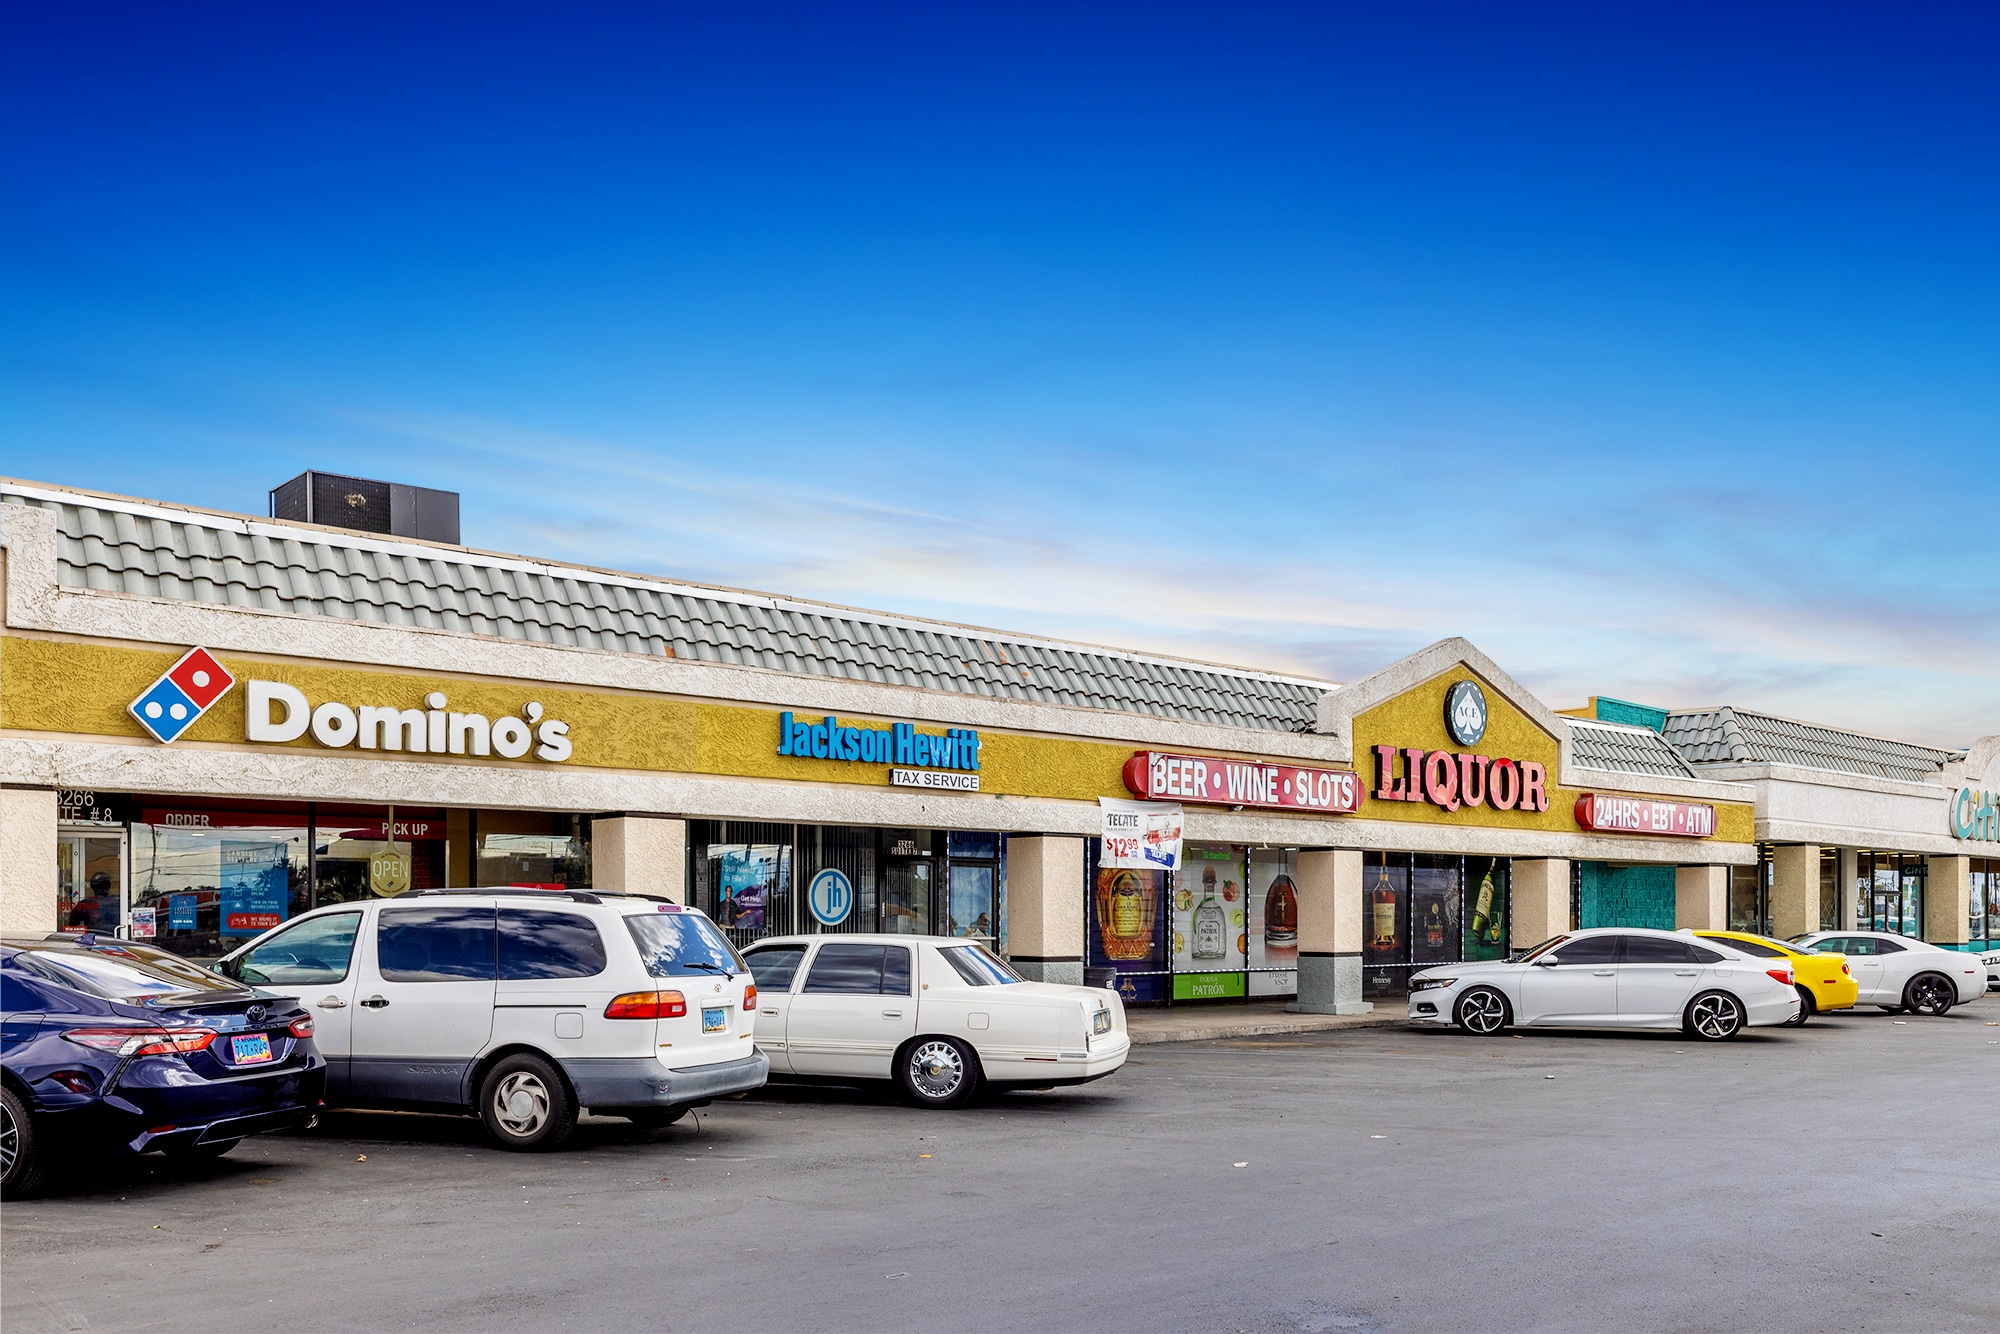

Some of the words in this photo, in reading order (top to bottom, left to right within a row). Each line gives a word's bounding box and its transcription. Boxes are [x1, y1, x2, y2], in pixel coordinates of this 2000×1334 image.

[245, 680, 573, 762] Domino's
[1459, 706, 1478, 719] ACE
[780, 711, 893, 764] Jackson
[893, 722, 980, 770] Hewitt
[895, 771, 920, 784] TAX
[923, 775, 978, 789] SERVICE
[1153, 757, 1208, 798] BEER
[1226, 764, 1279, 803] WINE
[1296, 771, 1354, 809] SLOTS
[1371, 745, 1550, 813] LIQUOR
[165, 813, 210, 827] ORDER
[1106, 813, 1139, 827] TECATE
[1596, 798, 1640, 829] 24HRS
[1651, 803, 1676, 831] EBT
[1686, 807, 1711, 834] ATM
[1955, 787, 2000, 842] Citi
[382, 822, 409, 835] PCK
[412, 823, 428, 836] UP
[372, 860, 409, 880] OPEN
[58, 901, 99, 911] elcome
[406, 1066, 458, 1075] SIENNA
